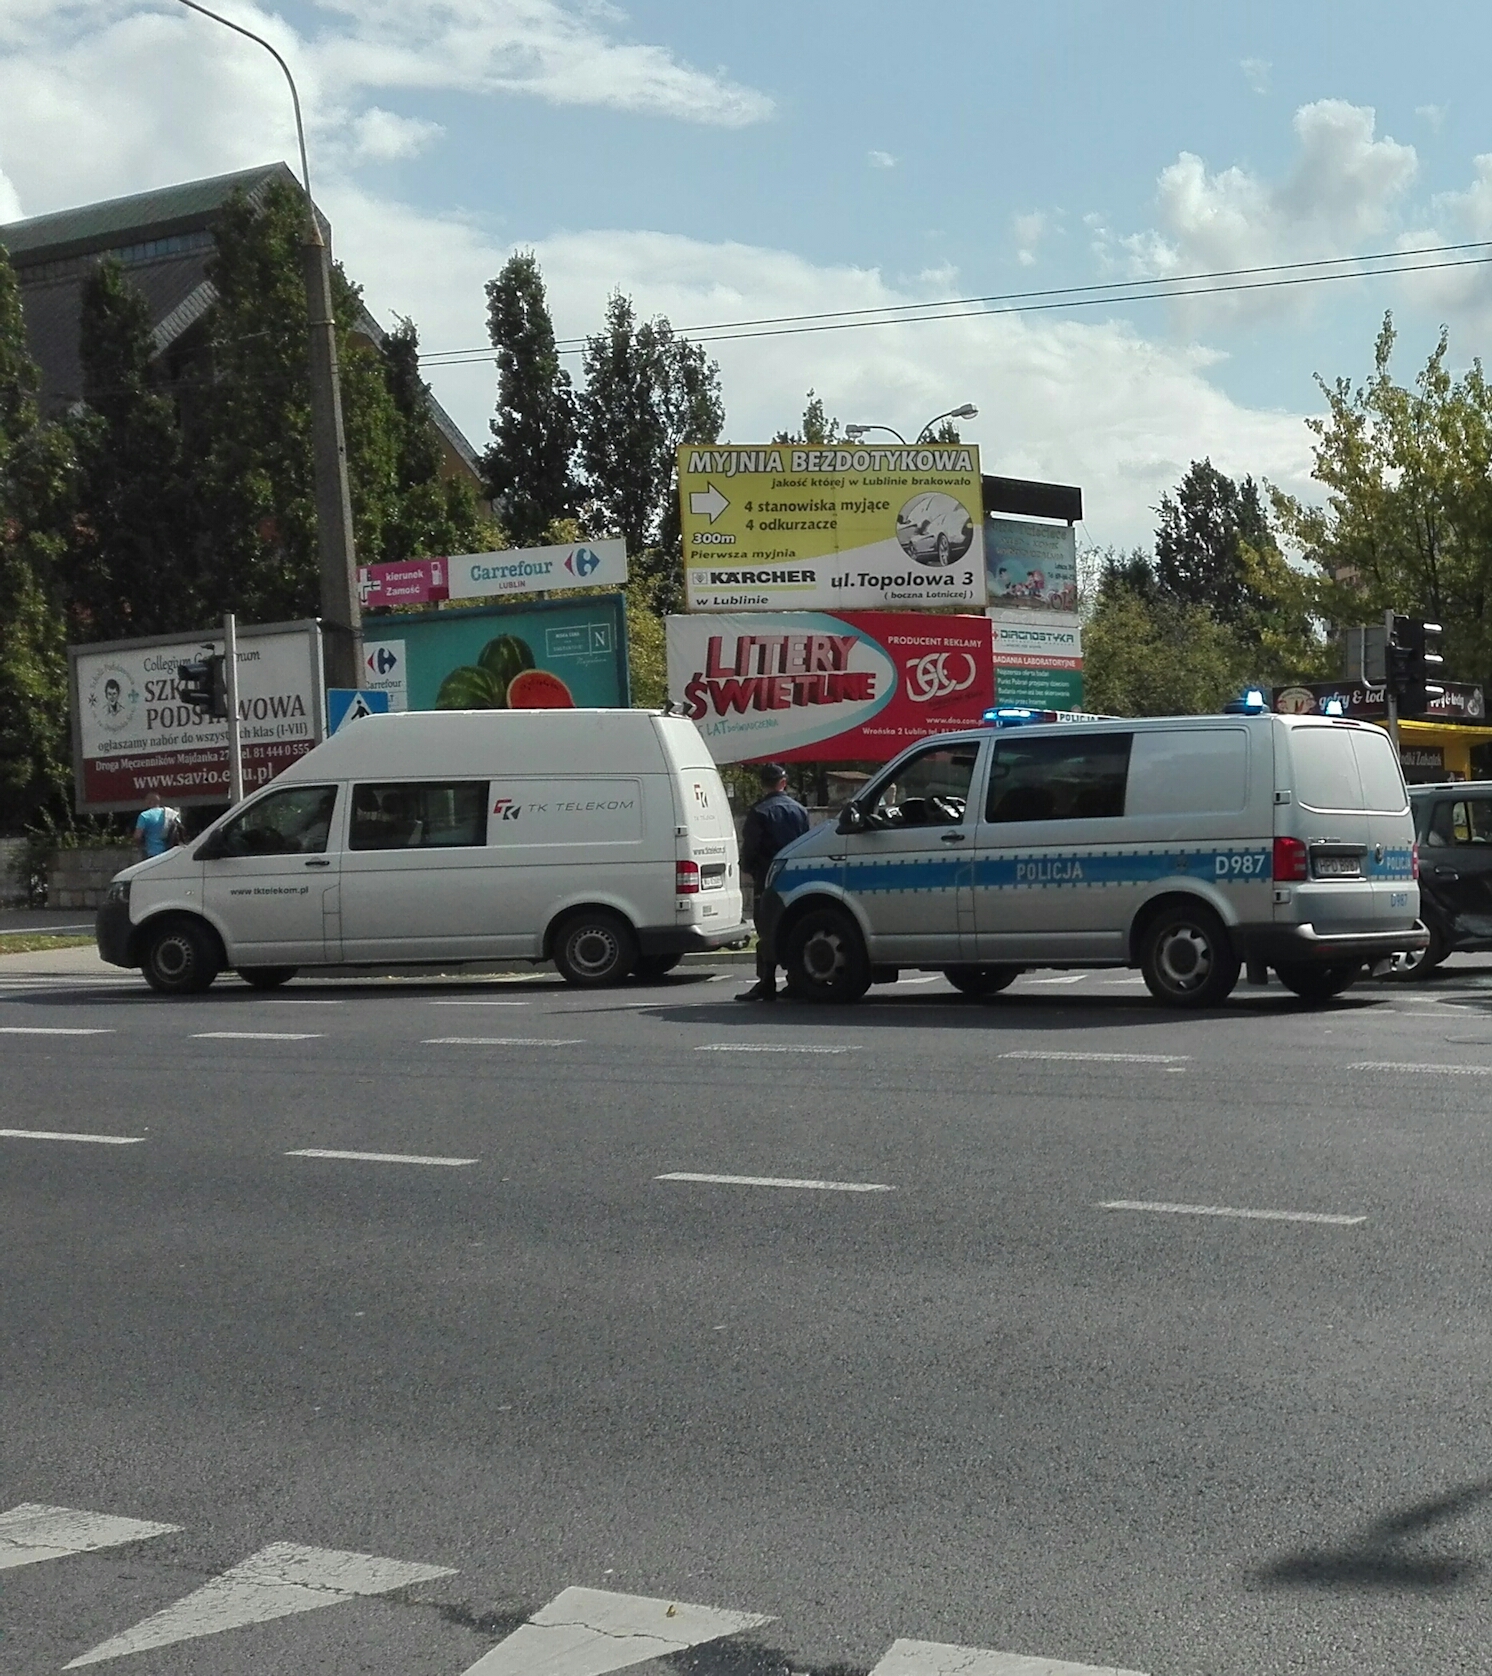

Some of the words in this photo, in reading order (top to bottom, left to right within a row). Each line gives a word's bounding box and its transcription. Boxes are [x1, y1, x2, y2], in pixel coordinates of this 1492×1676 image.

[688, 450, 784, 477] MYJNIA
[791, 450, 973, 472] BEZDOTYKOWA
[771, 477, 808, 488] jakość
[811, 477, 845, 488] której
[863, 477, 908, 486] Lublinie
[911, 477, 971, 486] brakowało
[745, 501, 753, 512] 4
[758, 501, 836, 512] stanowiska
[841, 500, 890, 512] myjące
[746, 519, 754, 531] 4
[759, 518, 837, 530] odkurzacze
[692, 532, 736, 545] 300m
[691, 549, 747, 559] Pierwsza
[752, 549, 796, 559] myjnia
[386, 569, 423, 581] kierunek
[471, 560, 552, 581] Carrefour
[710, 570, 816, 585] KÄRCHER
[499, 580, 526, 589] LUBLIN
[962, 572, 974, 585] 3
[386, 585, 420, 597] Zamość
[891, 591, 923, 599] boczna
[926, 590, 967, 600] Lotniczej
[714, 595, 769, 605] Lublinie
[595, 631, 605, 646] N
[888, 636, 941, 646] PRODUCENT
[944, 639, 982, 647] REKLAMY
[706, 636, 860, 678] LITERY
[993, 656, 1022, 664] BADANIA
[1024, 658, 1075, 667] LABORATORYJNE
[144, 655, 190, 674] Collegium
[684, 673, 876, 720] ŚWIETLNE
[1353, 690, 1362, 704] &
[1366, 689, 1384, 703] lod
[146, 695, 306, 730] PODSWOWA
[98, 739, 148, 753] ogłaszamy
[150, 734, 179, 747] nabór
[181, 733, 193, 743] do
[196, 728, 250, 743] wszystch
[253, 726, 274, 738] klas
[95, 760, 119, 773] Droga
[121, 755, 176, 771] Męczenników
[177, 750, 218, 765] Majdanka
[241, 748, 252, 759] el.
[253, 747, 264, 758] 81
[266, 745, 283, 757] 444
[285, 745, 291, 755] 0
[292, 742, 310, 755] 555
[133, 762, 273, 789] www.savio.eu.pl
[528, 804, 548, 812] TK
[557, 801, 634, 812] TELEKOM
[1017, 861, 1083, 880] POLICJA
[1215, 855, 1265, 875] D987
